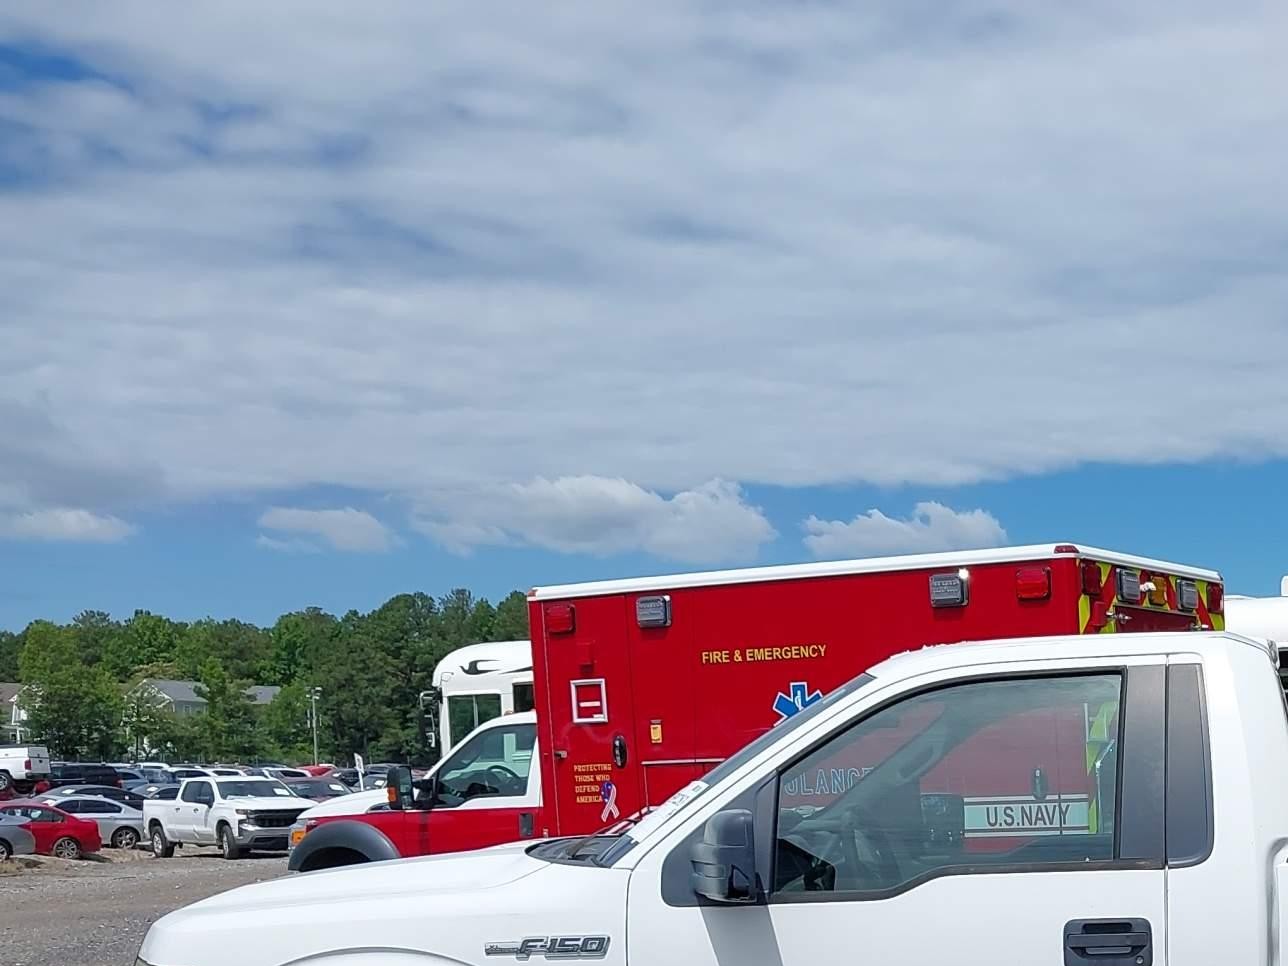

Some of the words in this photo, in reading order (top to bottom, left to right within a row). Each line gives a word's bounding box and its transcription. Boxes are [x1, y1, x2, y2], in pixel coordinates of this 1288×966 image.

[702, 650, 731, 664] FIRE
[733, 649, 742, 662] &
[745, 644, 826, 662] EMERGENCY
[573, 763, 612, 772] PROTECTING
[574, 774, 594, 782] THOSE
[575, 784, 600, 793] DEFEND
[576, 795, 603, 803] AMERICA
[518, 936, 611, 960] F-150
